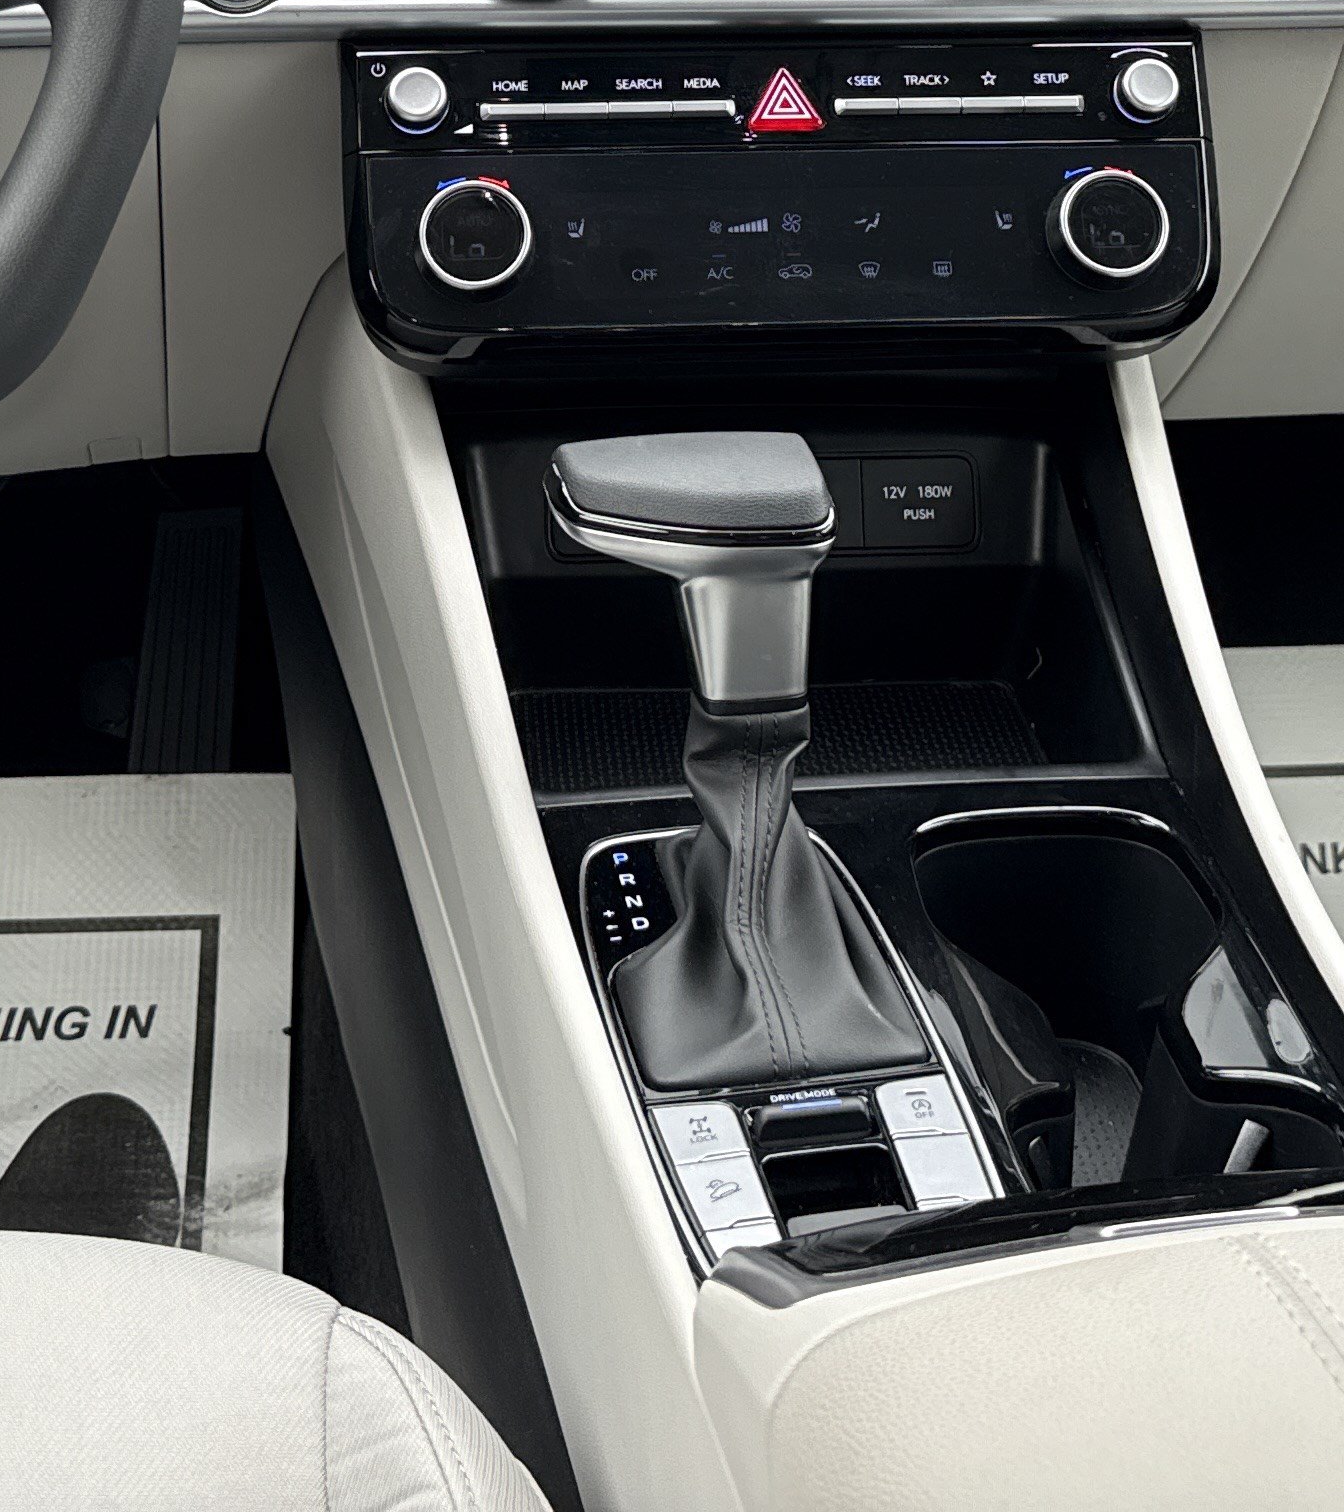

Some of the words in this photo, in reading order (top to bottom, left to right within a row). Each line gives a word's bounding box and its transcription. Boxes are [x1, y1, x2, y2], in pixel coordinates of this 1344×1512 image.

[560, 79, 589, 91] MAP
[614, 77, 662, 91] SEARCH
[682, 77, 721, 89] MEDIA
[1033, 72, 1070, 85] SETUP
[492, 80, 529, 93] HOME
[631, 268, 658, 281] OFF
[707, 266, 734, 280] A/C
[882, 486, 906, 499] 12V
[917, 485, 953, 499] 180W
[903, 508, 935, 520] PUSH
[613, 853, 628, 868] P
[618, 873, 636, 886] R
[625, 894, 643, 908] N
[631, 916, 650, 930] D
[103, 1002, 158, 1041] IN
[769, 1091, 805, 1103] DRIVE
[804, 1088, 837, 1100] MODE
[914, 1110, 935, 1119] OFF
[689, 1133, 718, 1144] LOCK
